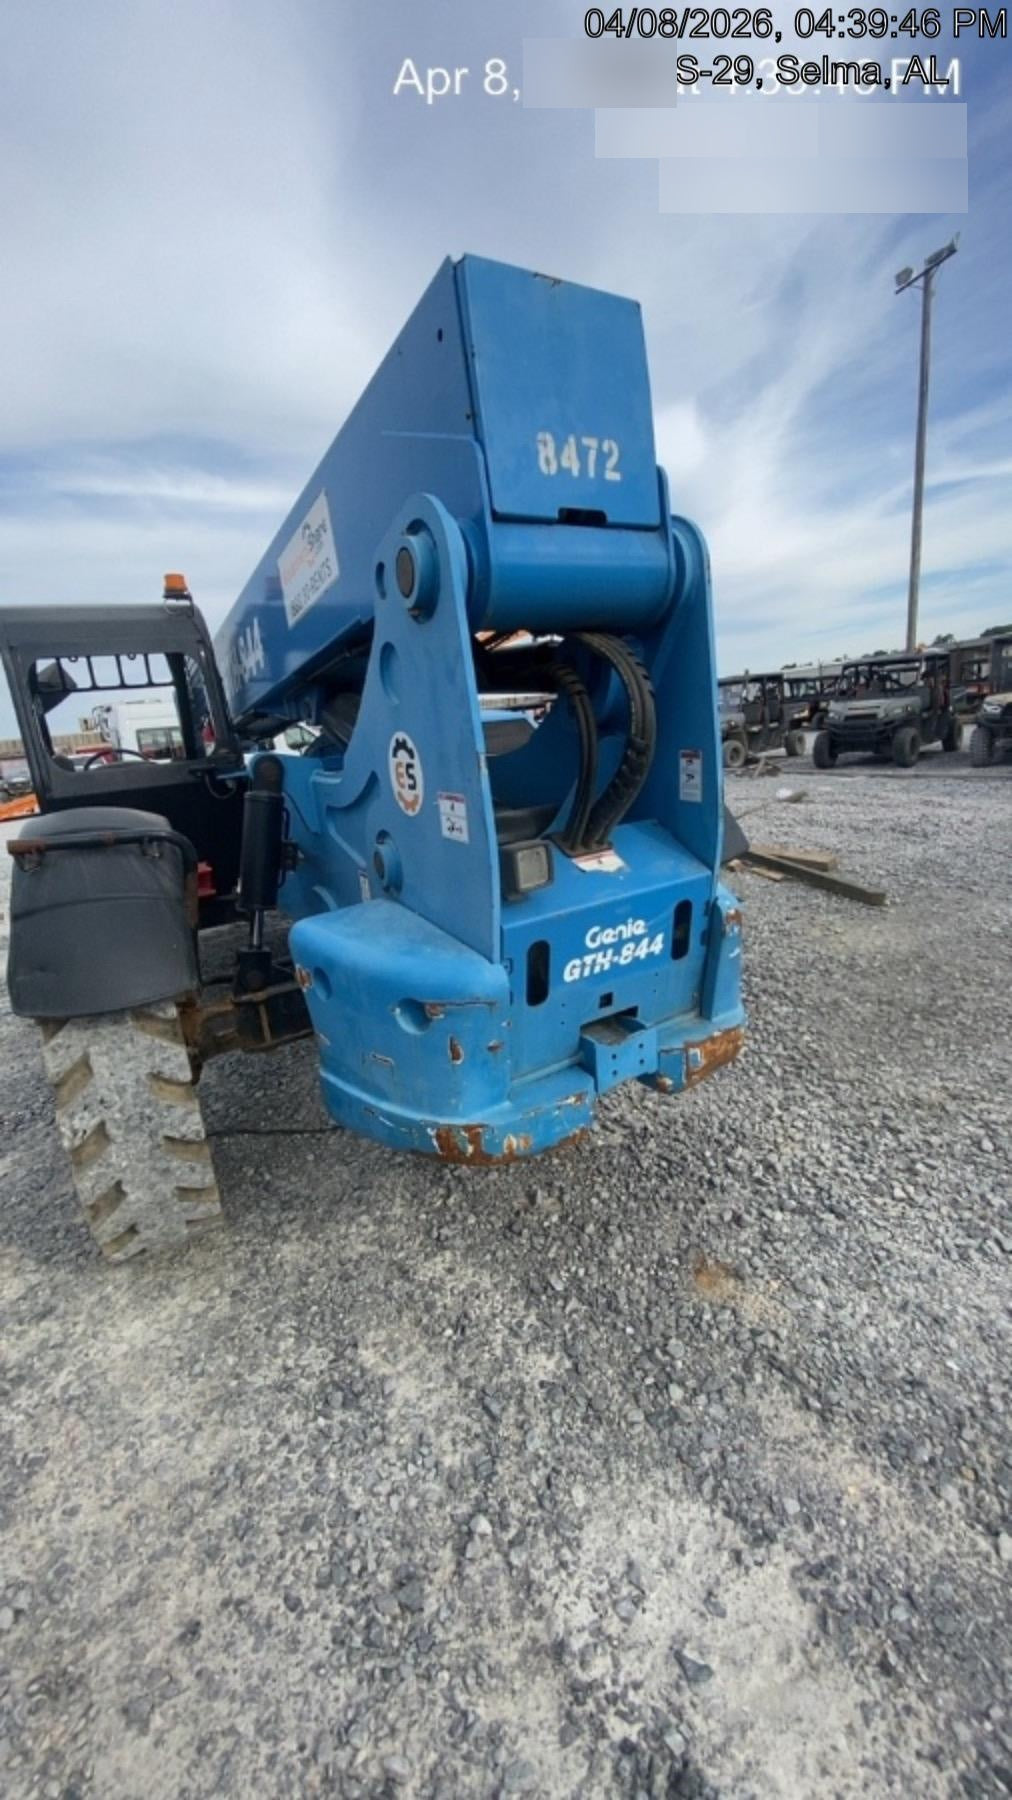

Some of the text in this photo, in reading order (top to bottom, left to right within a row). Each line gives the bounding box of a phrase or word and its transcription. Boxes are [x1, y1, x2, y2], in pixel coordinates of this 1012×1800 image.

[536, 431, 622, 481] 8472
[395, 761, 418, 791] ES
[585, 917, 647, 949] Genie
[563, 932, 664, 983] GTH-844
